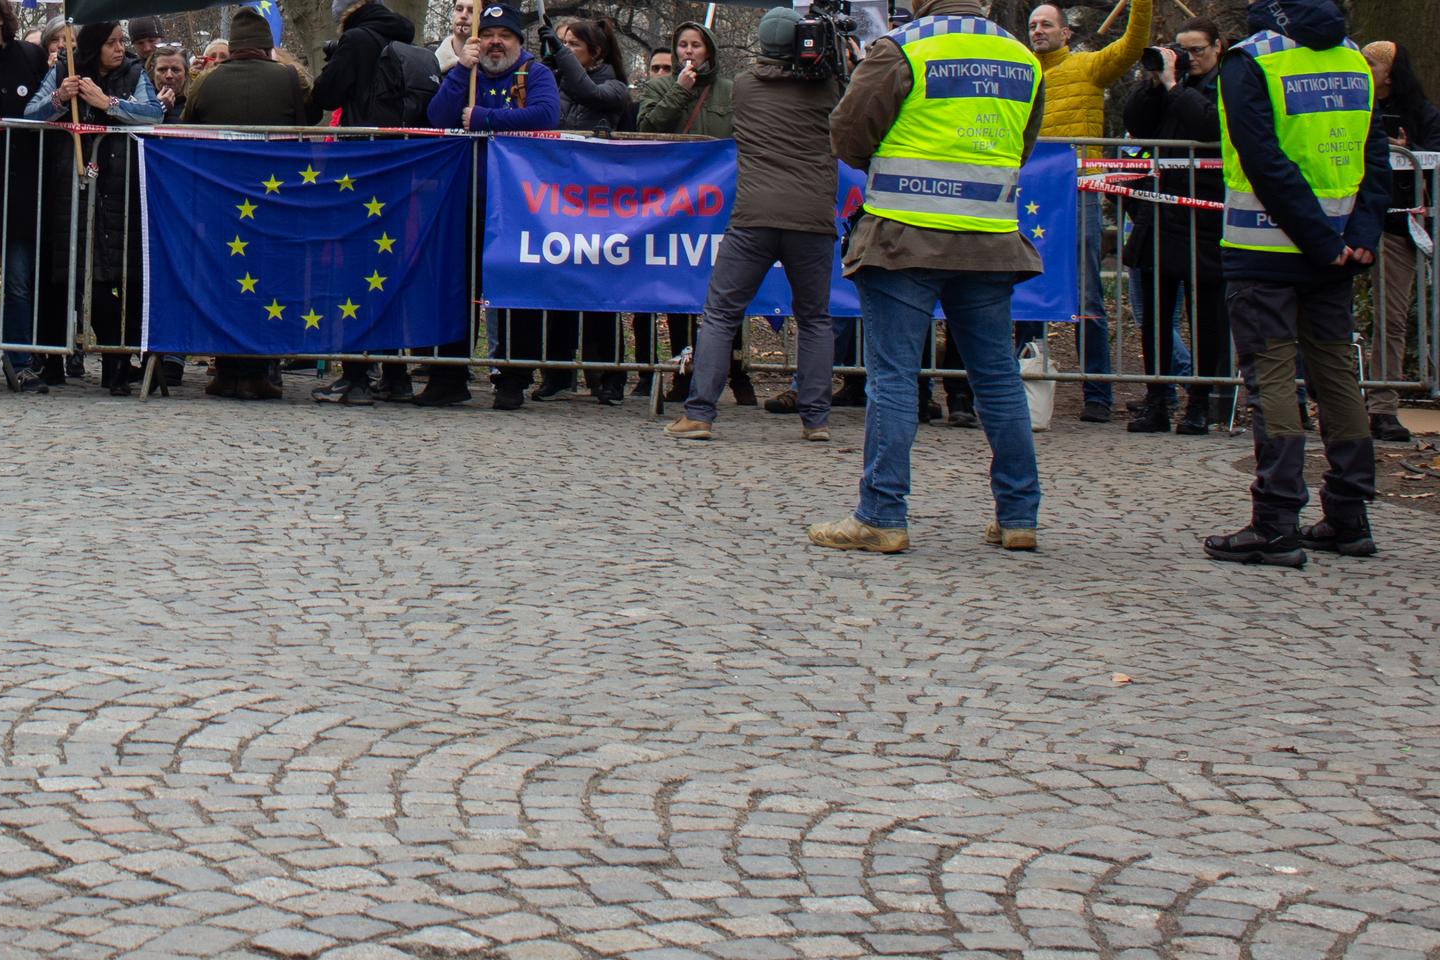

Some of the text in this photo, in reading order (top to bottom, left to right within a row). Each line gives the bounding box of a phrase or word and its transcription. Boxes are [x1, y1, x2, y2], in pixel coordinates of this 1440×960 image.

[928, 62, 1033, 82] ANTIKONFLIKTNÍ
[972, 79, 999, 95] TÝM
[975, 113, 999, 124] ANTI
[898, 178, 963, 196] POLICIE
[521, 181, 724, 218] VISEGRAD
[519, 231, 630, 265] LONG
